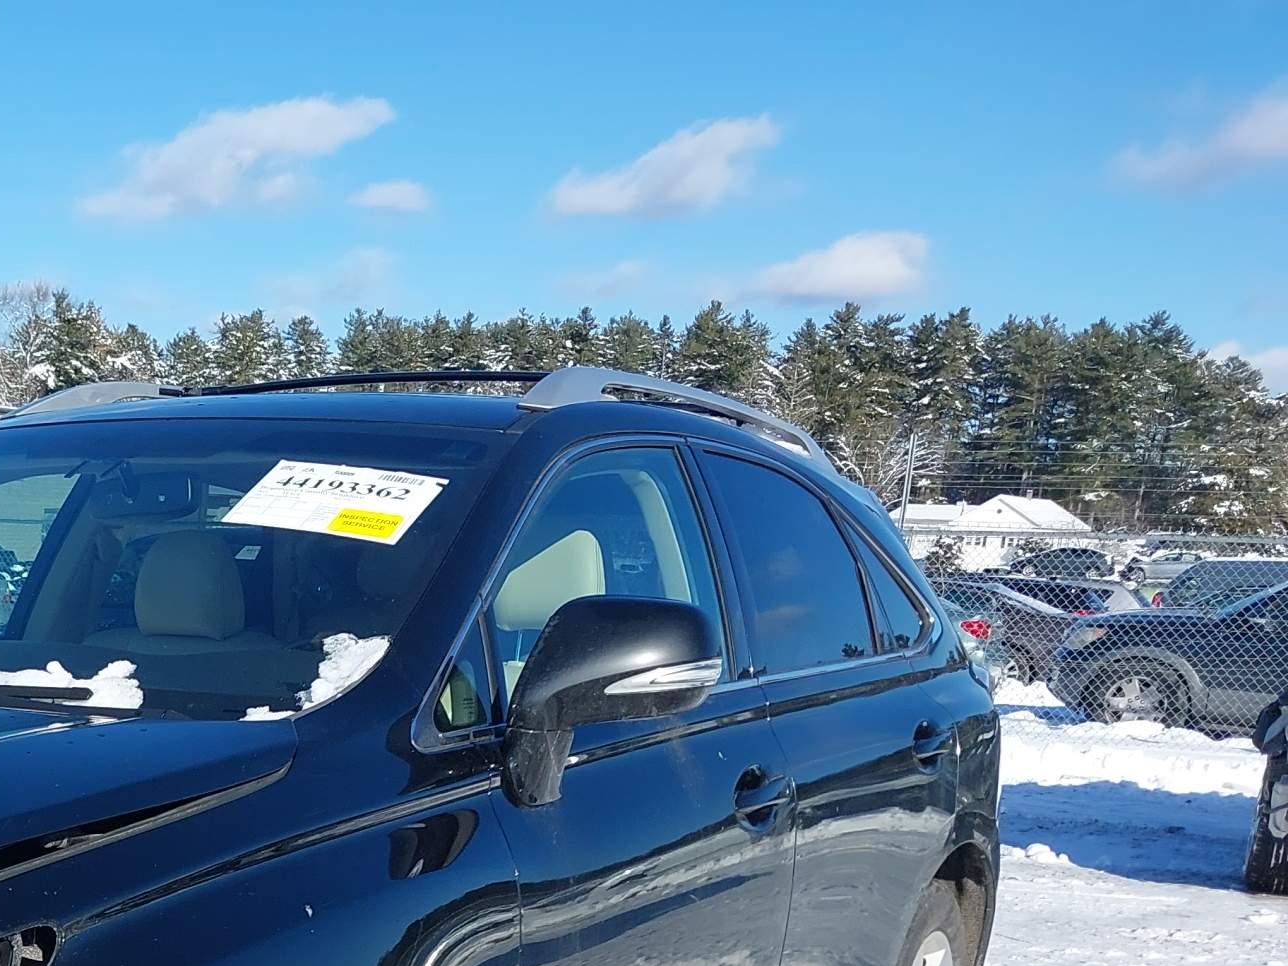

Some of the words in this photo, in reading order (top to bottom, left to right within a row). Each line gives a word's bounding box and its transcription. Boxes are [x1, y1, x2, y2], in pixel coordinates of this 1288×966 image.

[276, 475, 411, 501] 44193362
[338, 512, 399, 527] INSPECTION
[342, 520, 386, 531] SERVICE
